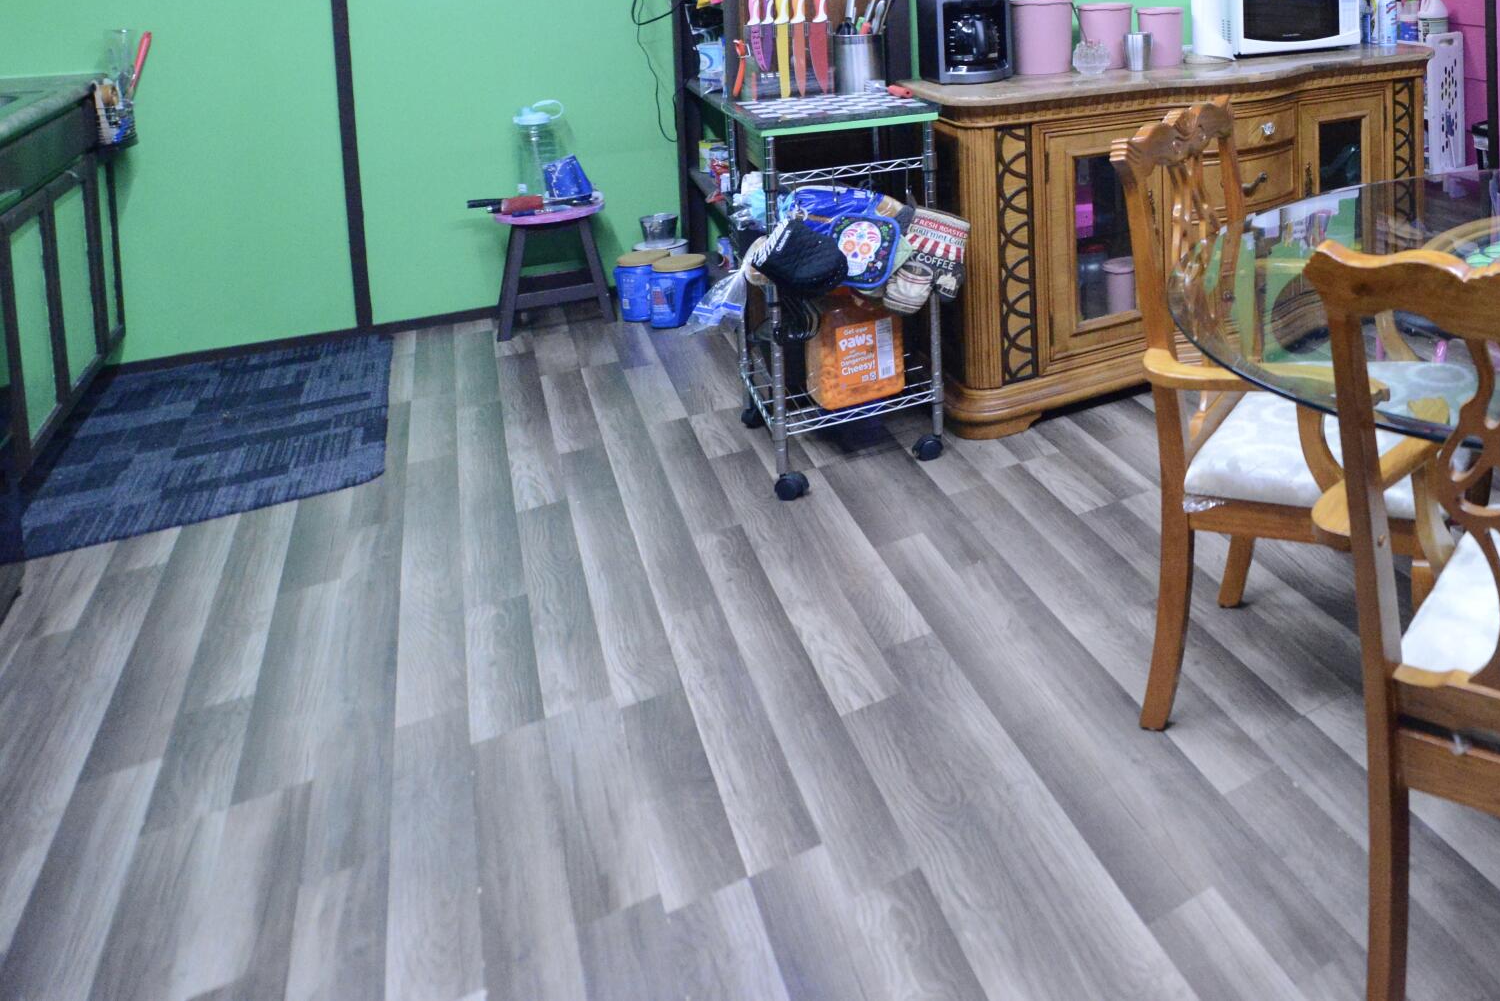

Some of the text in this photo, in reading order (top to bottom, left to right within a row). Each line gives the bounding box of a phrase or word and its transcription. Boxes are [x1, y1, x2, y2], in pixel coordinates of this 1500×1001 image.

[909, 225, 947, 242] Gourmet
[913, 217, 969, 239] FRESH ROASTED
[917, 252, 956, 270] COFFEE
[841, 359, 876, 376] Cheesy!
